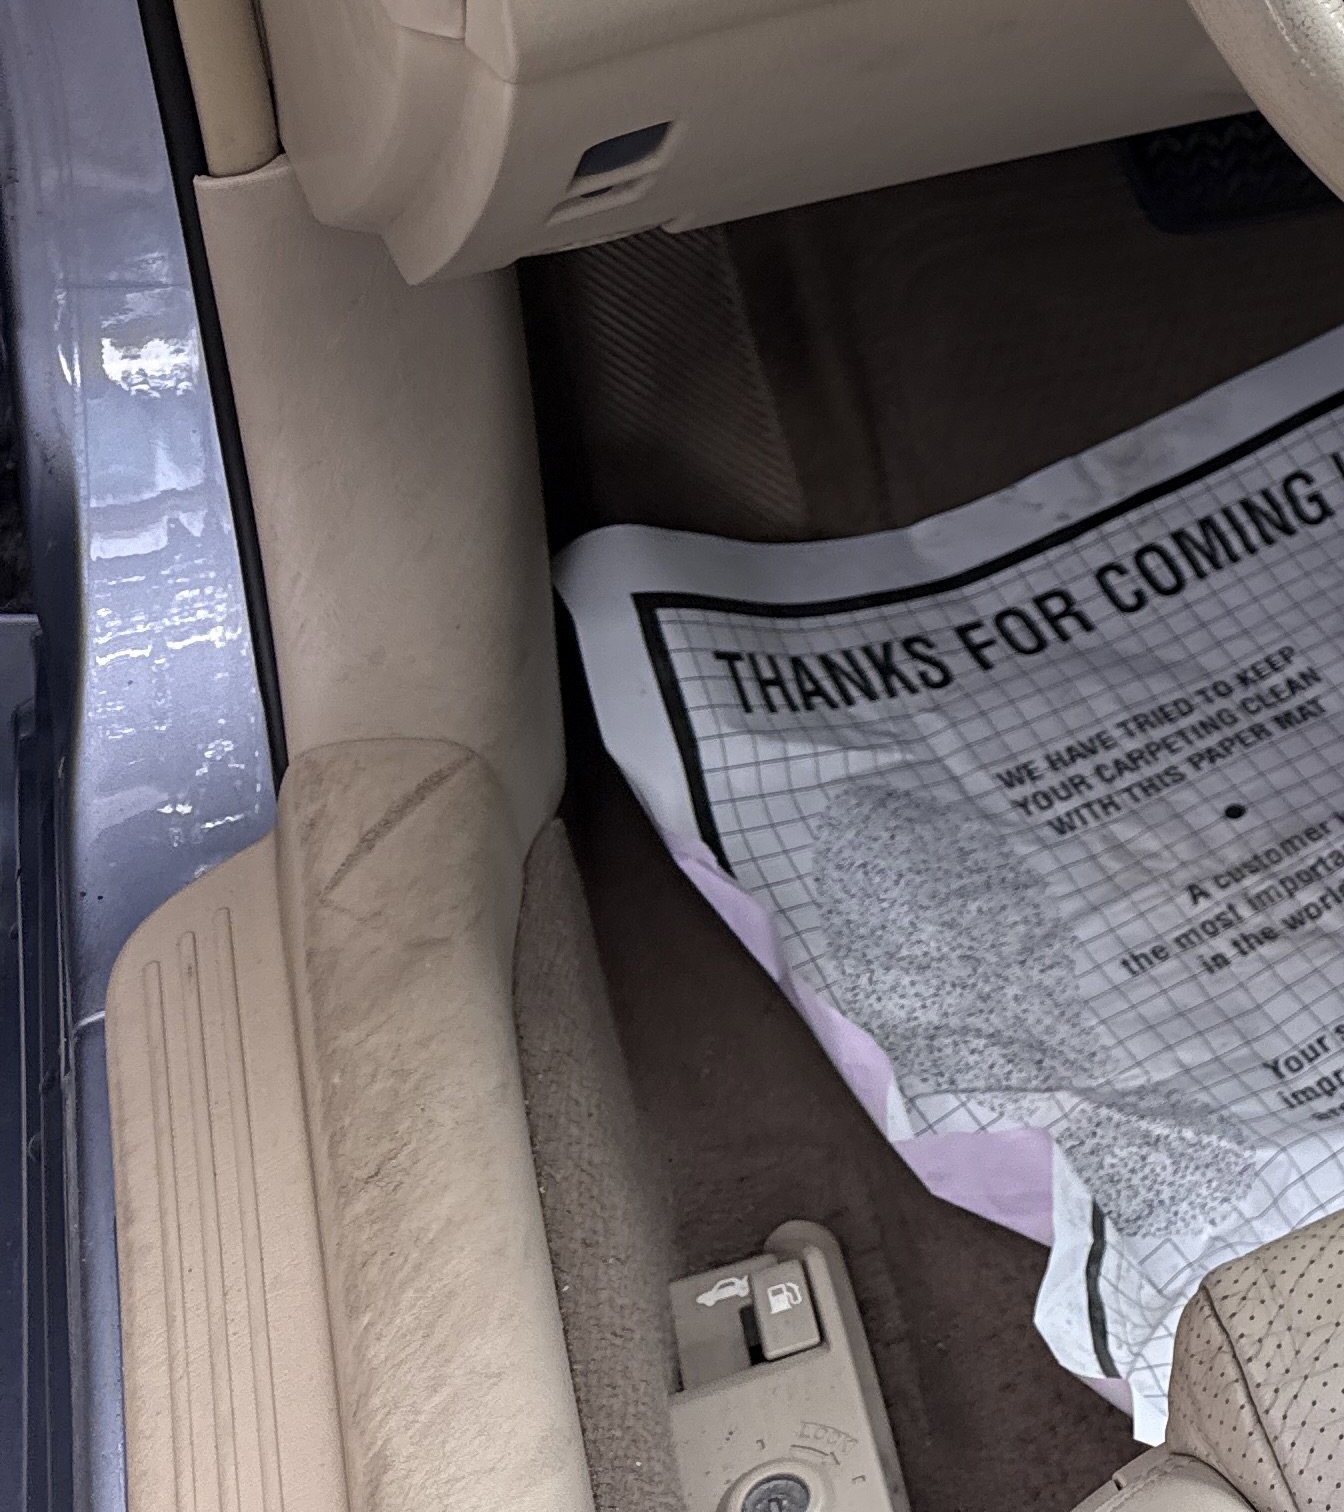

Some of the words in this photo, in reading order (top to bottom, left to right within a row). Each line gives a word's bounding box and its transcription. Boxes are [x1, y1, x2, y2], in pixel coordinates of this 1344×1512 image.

[712, 636, 955, 714] THANKS
[953, 588, 1095, 671] FOR
[1095, 469, 1336, 614] COMING
[995, 759, 1046, 789] WE
[1043, 729, 1118, 773] HAVE
[1115, 696, 1195, 739] TRIED
[1194, 678, 1235, 705] TO
[1235, 645, 1296, 687] KEEP
[1011, 772, 1094, 817] YOUR
[1093, 706, 1239, 785] CARPETING
[1238, 666, 1324, 716] CLEAN
[1046, 793, 1123, 837] WITH
[1121, 764, 1188, 805] THIS
[1186, 722, 1274, 772] PAPER
[1273, 695, 1328, 732] MAT
[1186, 882, 1211, 906] A
[1212, 818, 1333, 890] customer
[1120, 941, 1171, 978] the
[1172, 901, 1246, 950] most
[1200, 949, 1232, 975] in
[1230, 923, 1281, 958] the
[1262, 1032, 1333, 1081] Your
